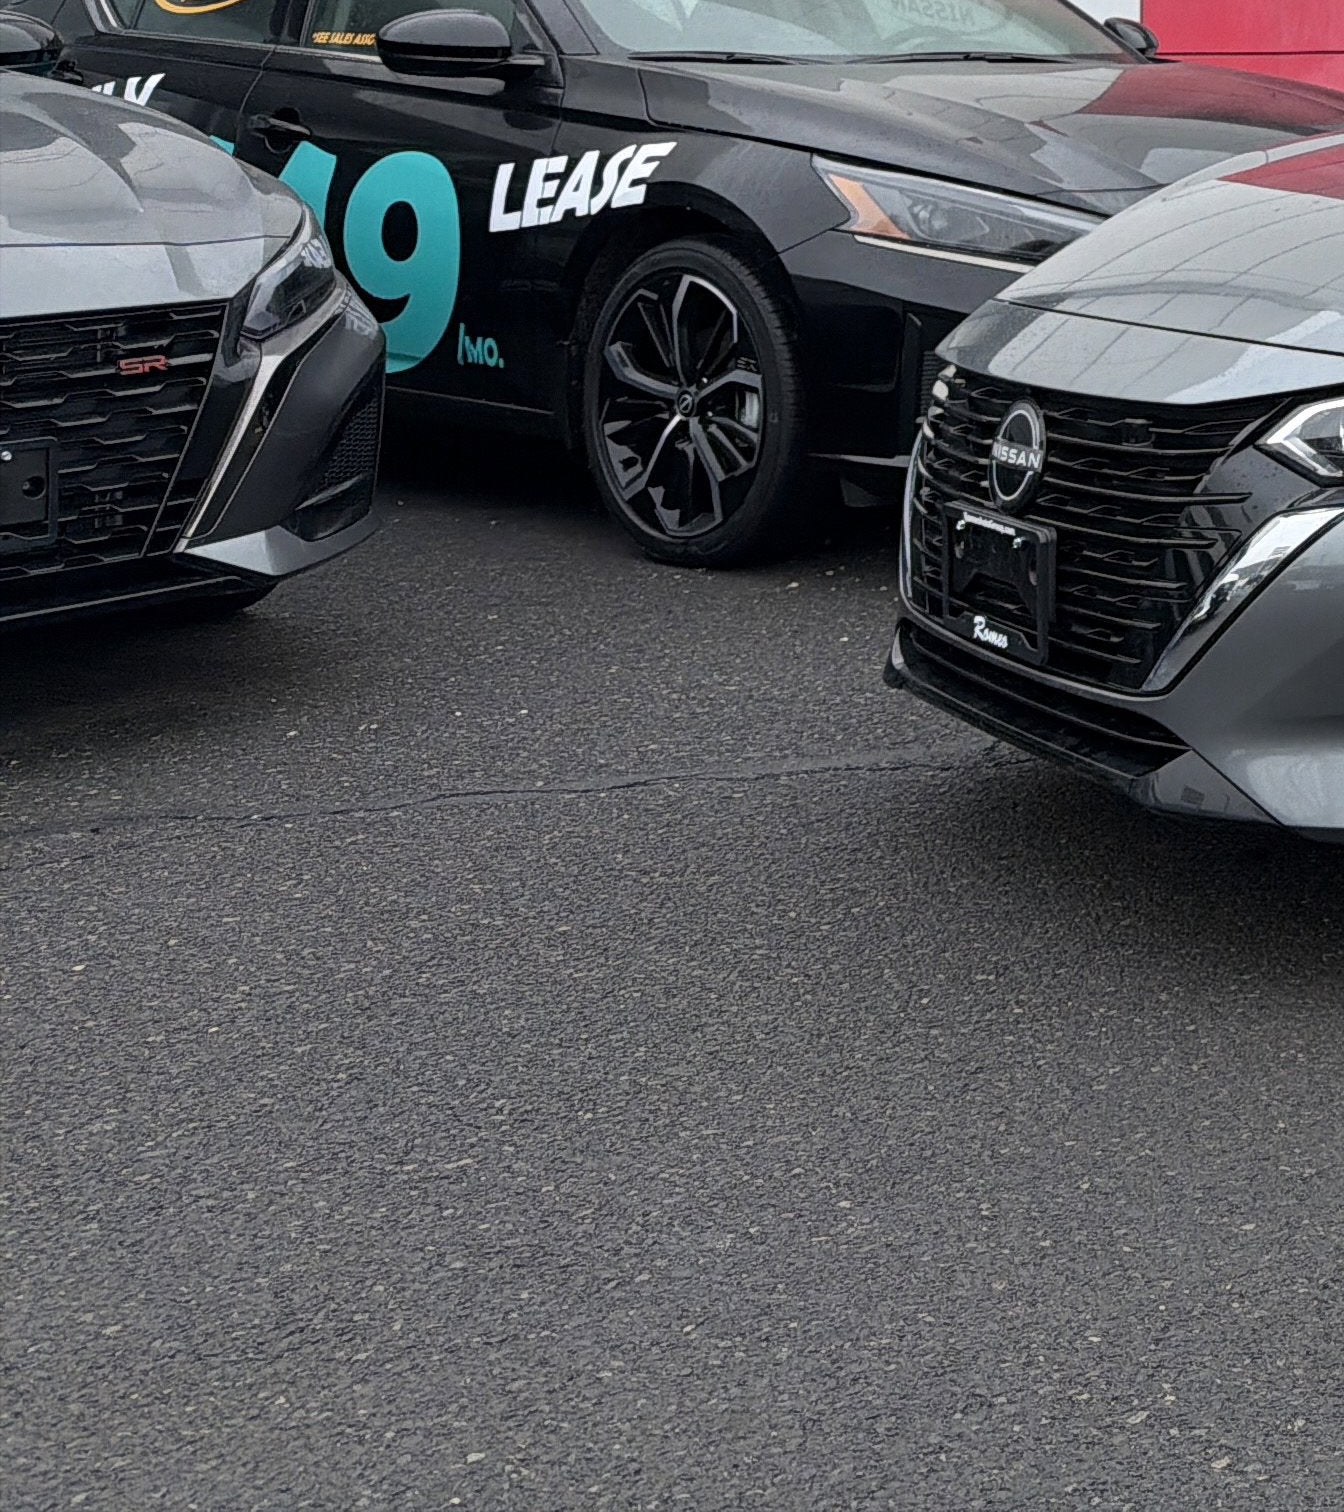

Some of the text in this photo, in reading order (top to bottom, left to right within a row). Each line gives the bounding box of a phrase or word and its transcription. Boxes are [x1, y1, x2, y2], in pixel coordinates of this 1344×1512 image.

[488, 141, 677, 233] LEASE
[457, 322, 505, 369] /MO.
[118, 354, 169, 376] SR
[991, 441, 1042, 470] NISSAN
